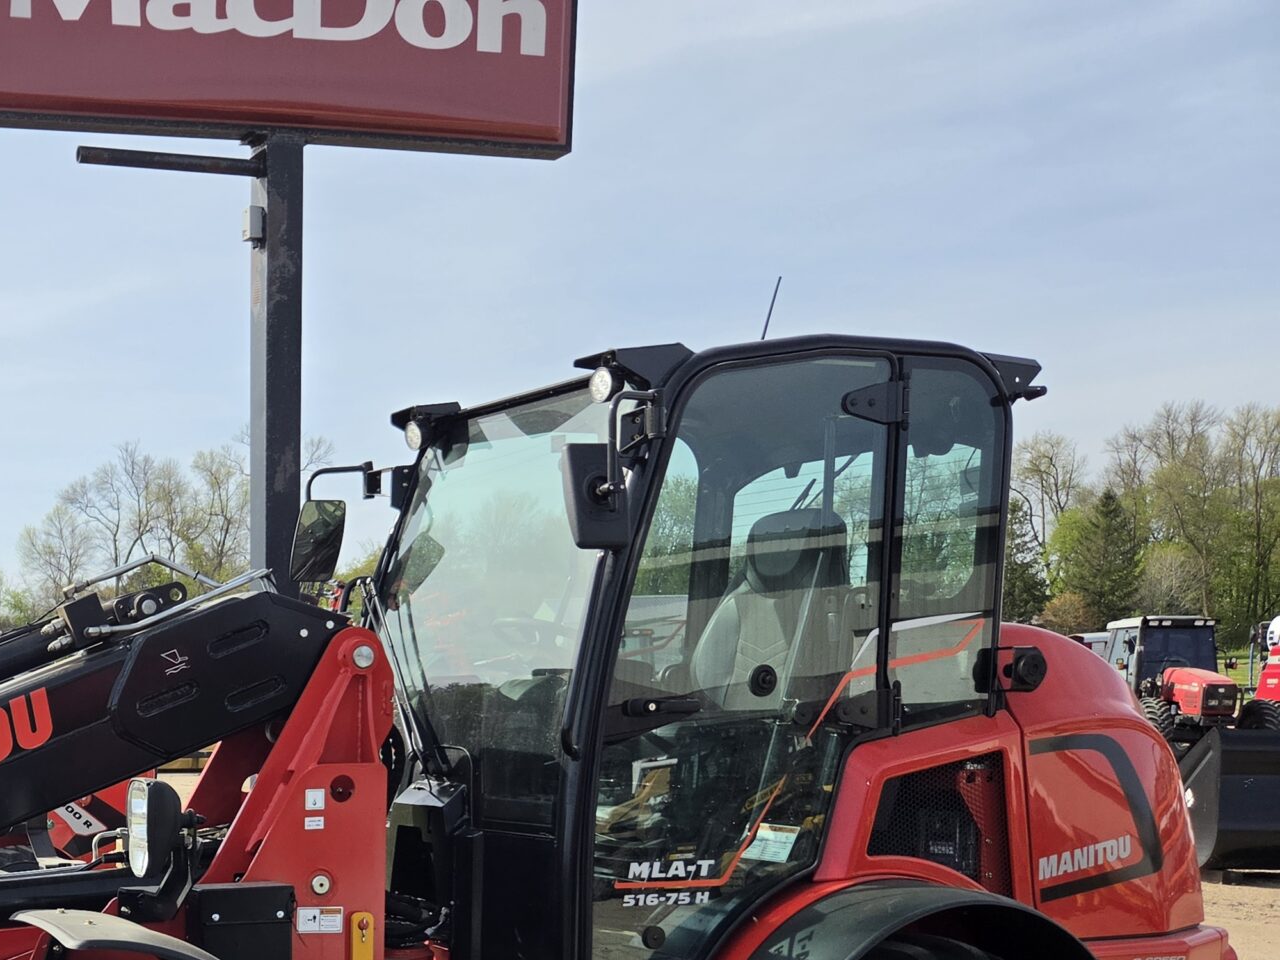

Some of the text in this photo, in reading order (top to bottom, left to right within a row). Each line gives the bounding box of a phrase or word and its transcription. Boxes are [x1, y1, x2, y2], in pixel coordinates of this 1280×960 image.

[82, 819, 93, 830] R
[1038, 834, 1132, 881] MANITOU
[628, 859, 715, 879] MLA-T
[622, 891, 710, 907] 516-75 H
